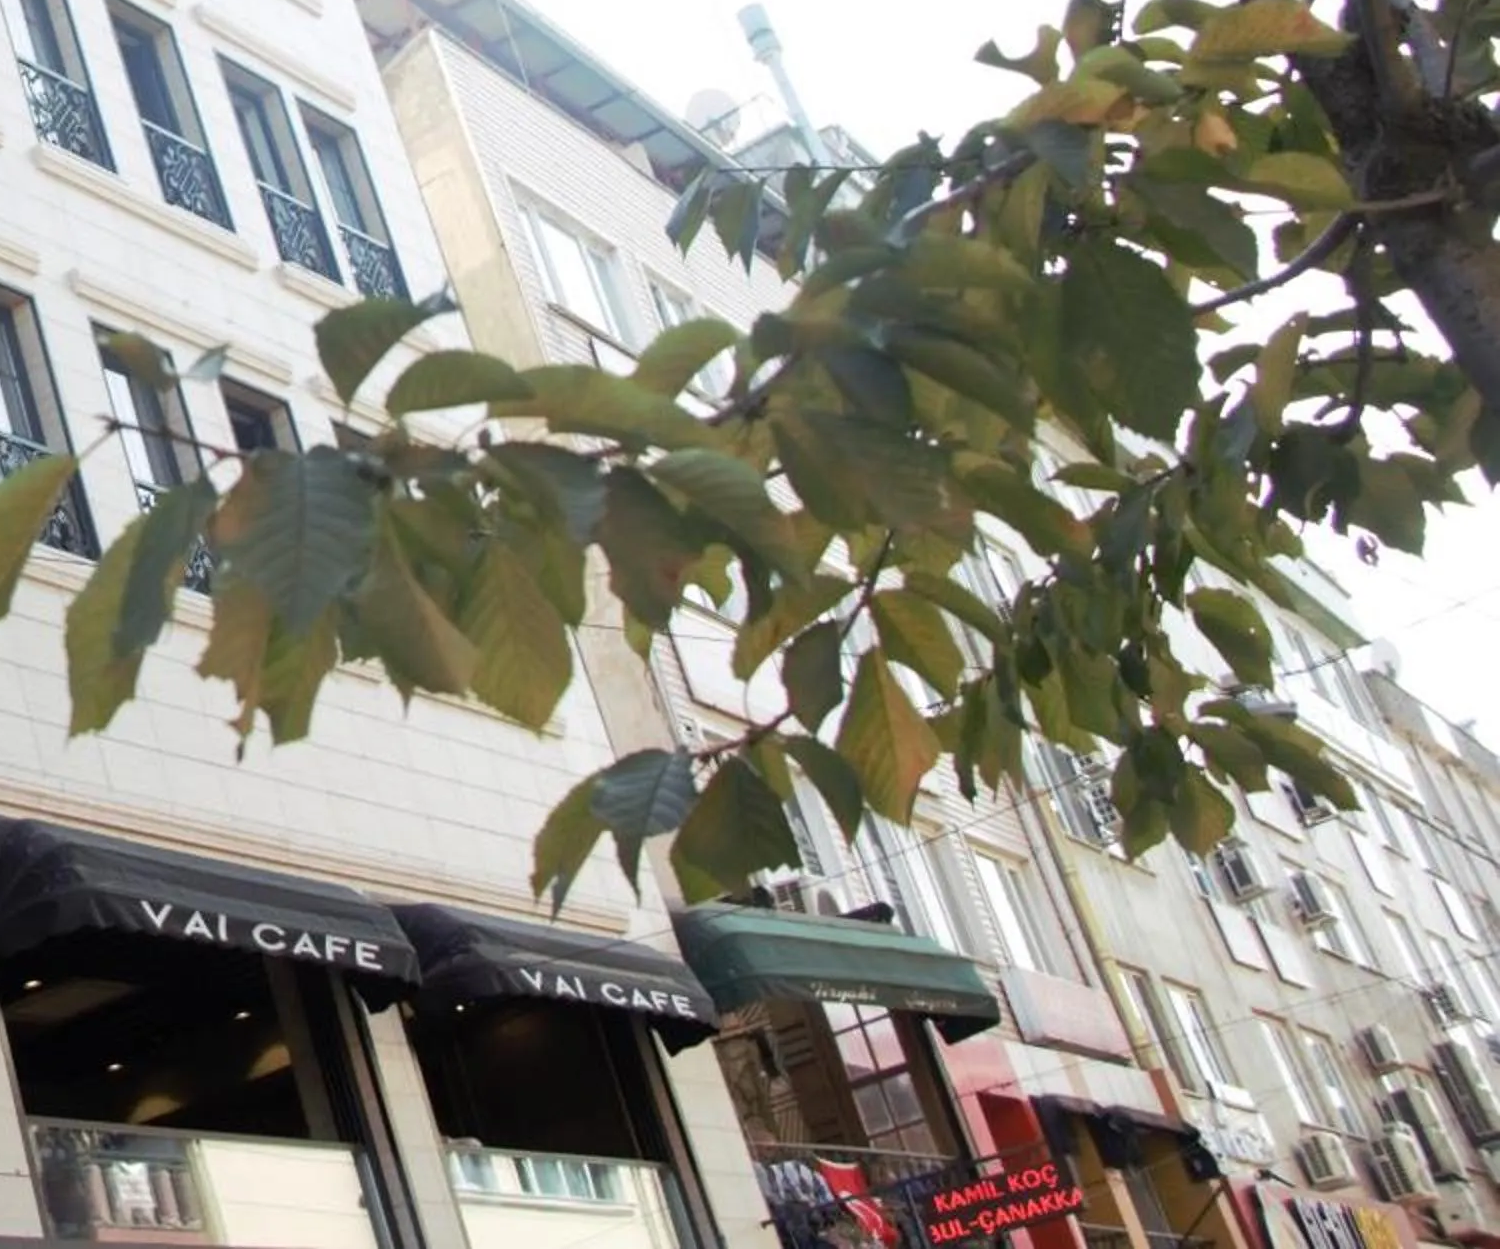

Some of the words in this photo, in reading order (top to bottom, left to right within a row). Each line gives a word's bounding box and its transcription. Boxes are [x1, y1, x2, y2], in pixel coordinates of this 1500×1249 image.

[140, 899, 228, 942] VAI
[252, 923, 383, 971] CAFE
[520, 967, 587, 1001] VAI
[600, 981, 697, 1019] CAFE
[1007, 1163, 1059, 1192] KOÇ
